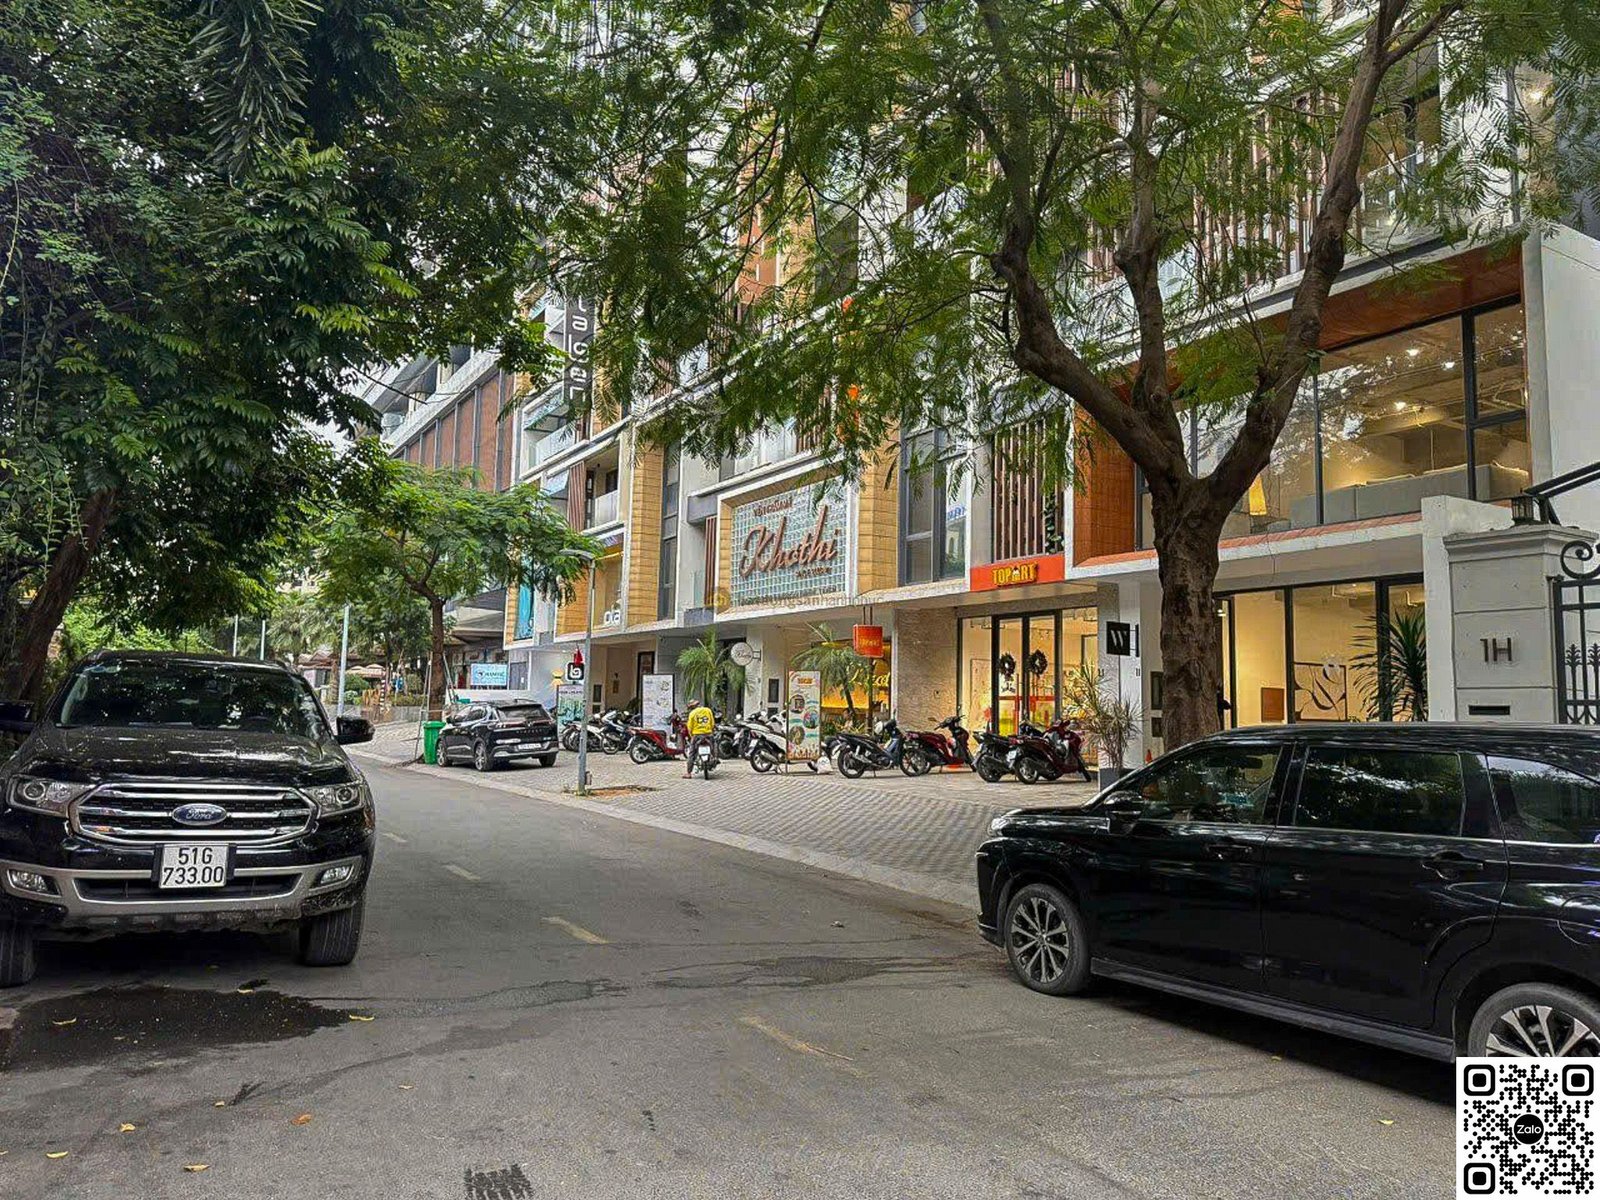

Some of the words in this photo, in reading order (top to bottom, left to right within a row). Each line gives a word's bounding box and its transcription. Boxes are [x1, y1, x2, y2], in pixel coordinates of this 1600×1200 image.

[1479, 637, 1512, 662] 1H
[184, 807, 217, 820] Ford
[178, 847, 213, 865] 51G
[162, 866, 224, 886] 733.00
